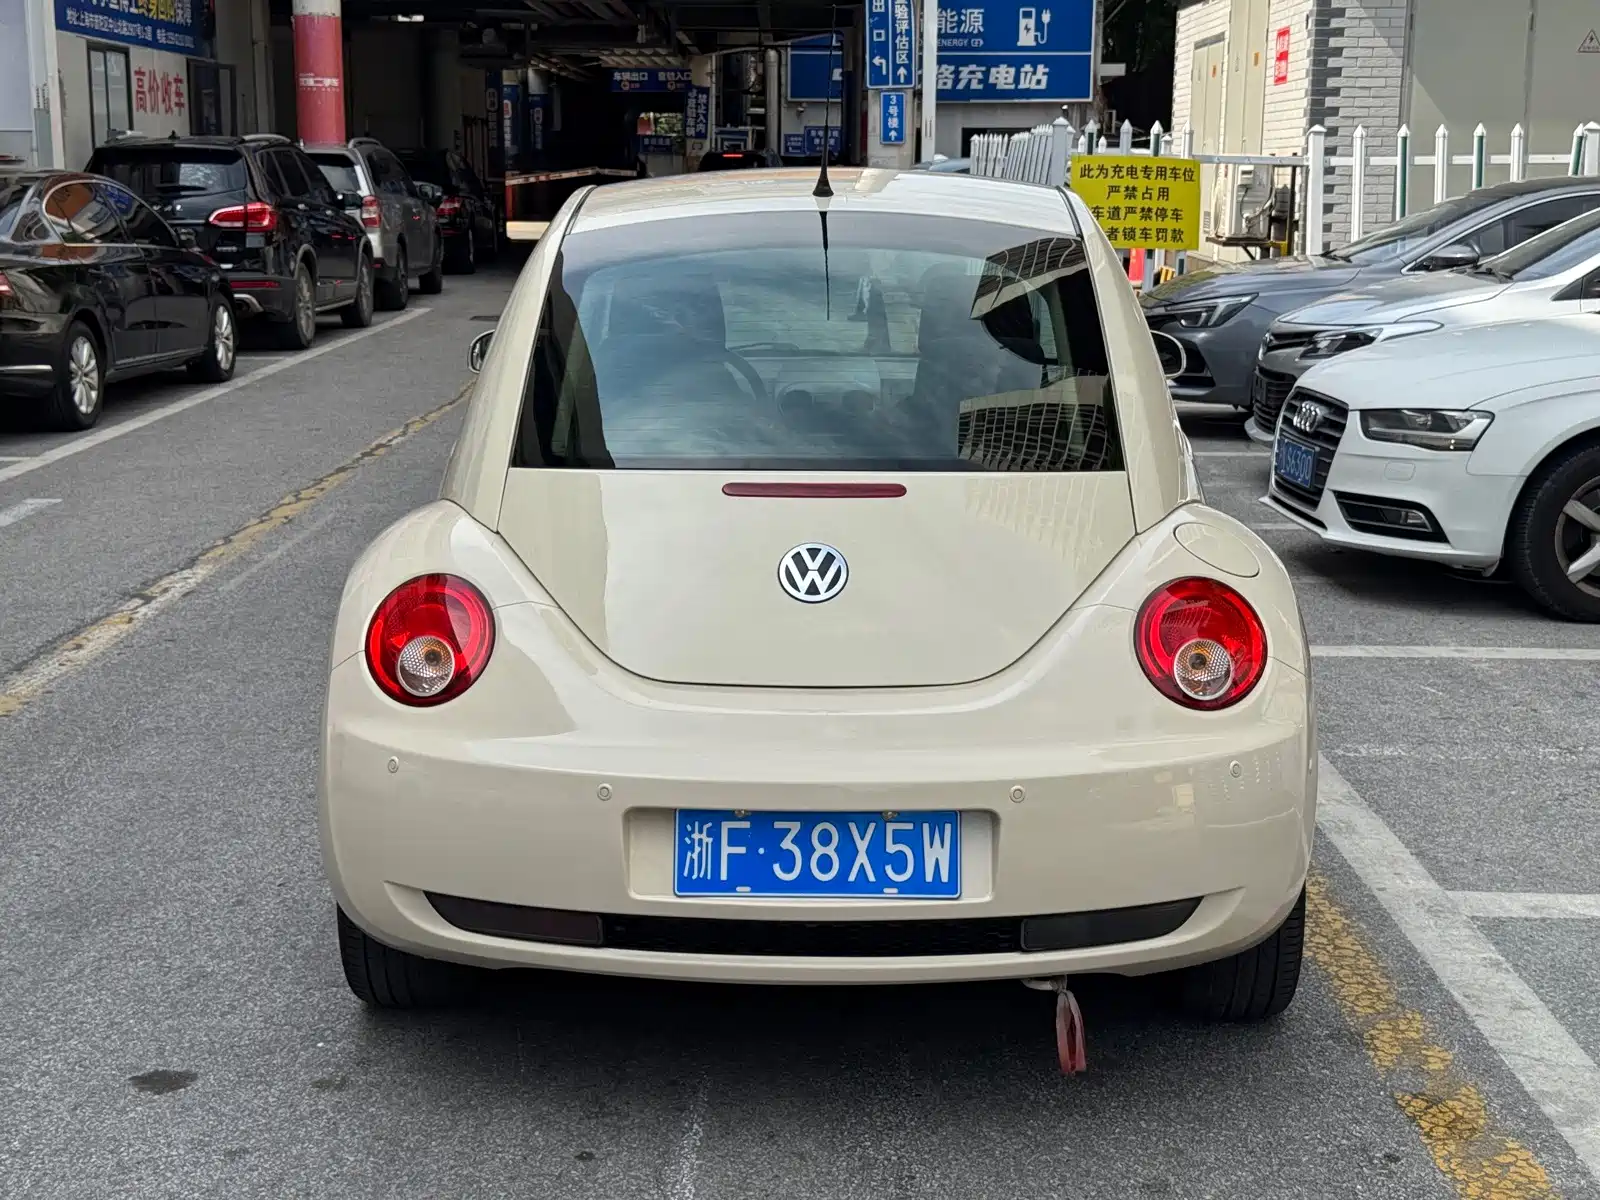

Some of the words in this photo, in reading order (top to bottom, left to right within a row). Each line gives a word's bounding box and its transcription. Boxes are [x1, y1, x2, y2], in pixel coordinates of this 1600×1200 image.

[873, 0, 886, 41] 出口
[894, 0, 909, 64] 验评估区
[134, 66, 186, 116] 高价收车
[888, 95, 899, 128] 3号楼
[1080, 163, 1196, 182] 此为充电专用车位
[1106, 184, 1170, 201] 严禁占用
[1091, 205, 1184, 223] 车道严禁停车
